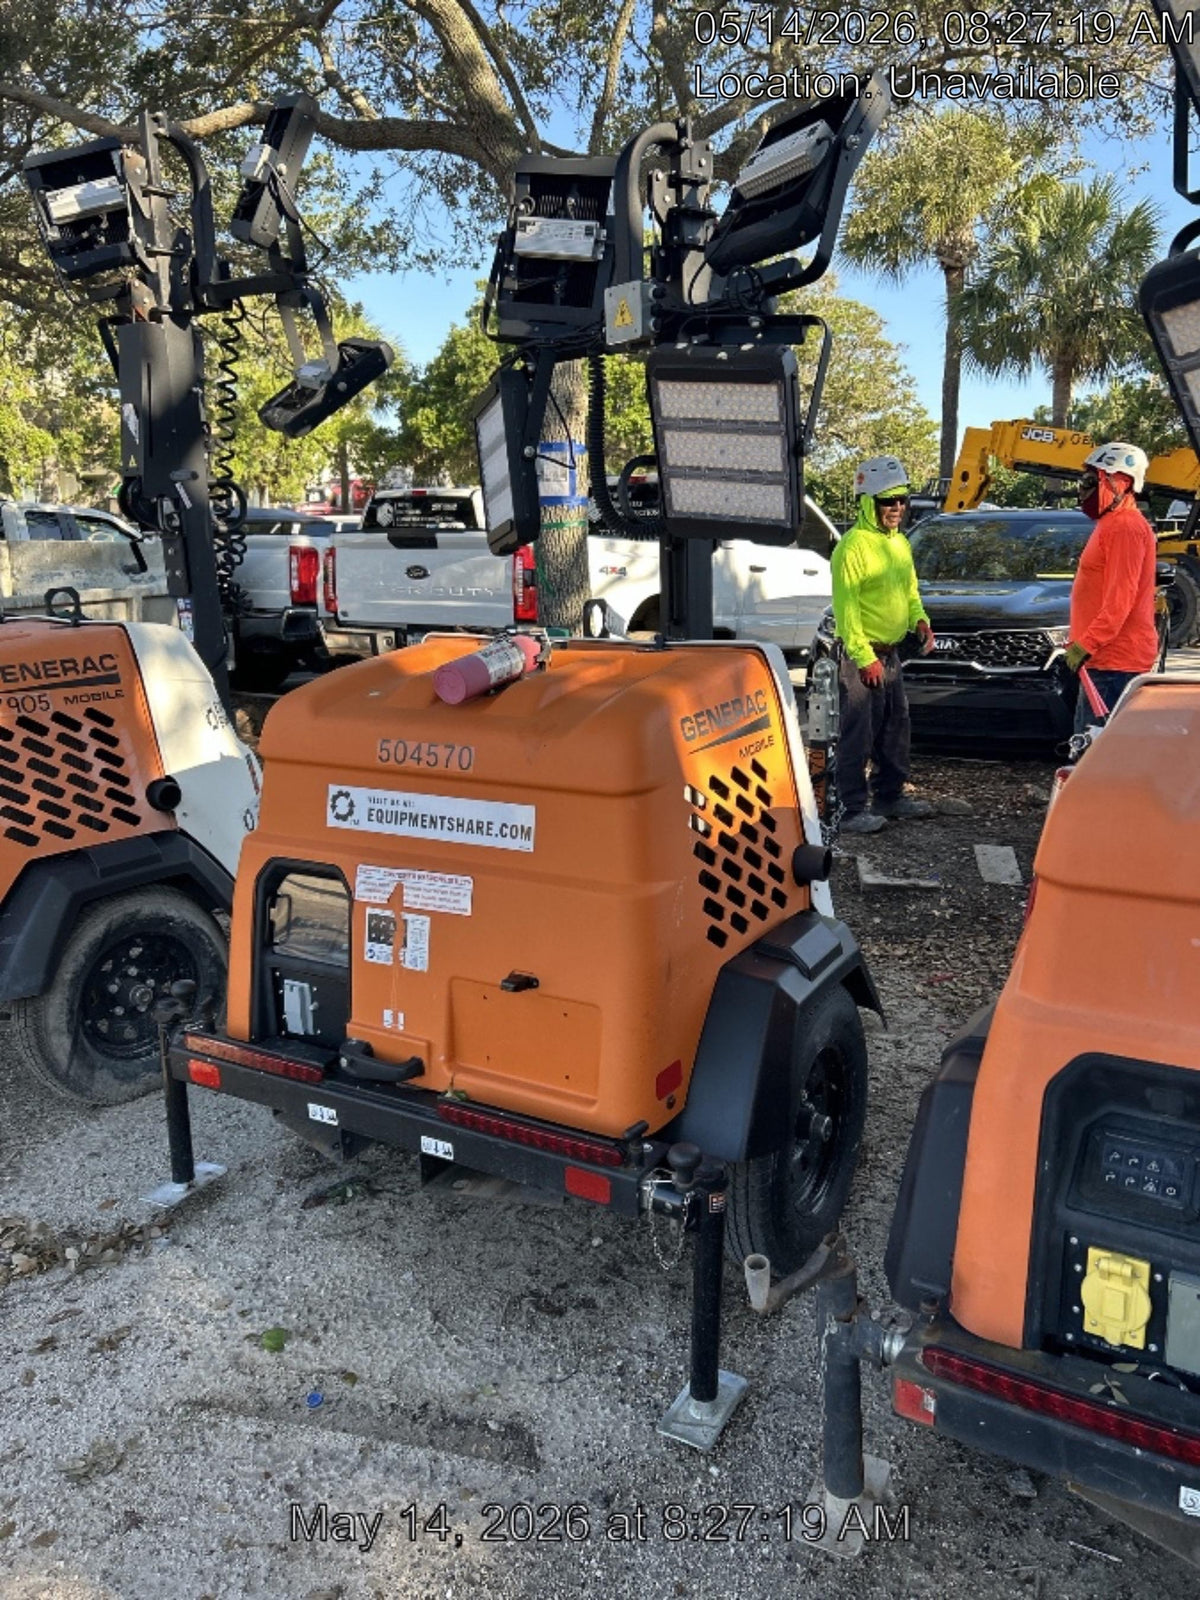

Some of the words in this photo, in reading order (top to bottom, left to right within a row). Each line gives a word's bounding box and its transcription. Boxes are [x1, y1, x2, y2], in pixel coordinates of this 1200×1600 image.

[1021, 427, 1054, 443] JCB
[0, 693, 50, 714] 905
[63, 689, 125, 706] MOBILE
[680, 689, 767, 742] GENERAC
[378, 739, 473, 770] 504570
[738, 734, 775, 758] MOBILE
[367, 808, 532, 841] EQUIPMENTSHARE.COM
